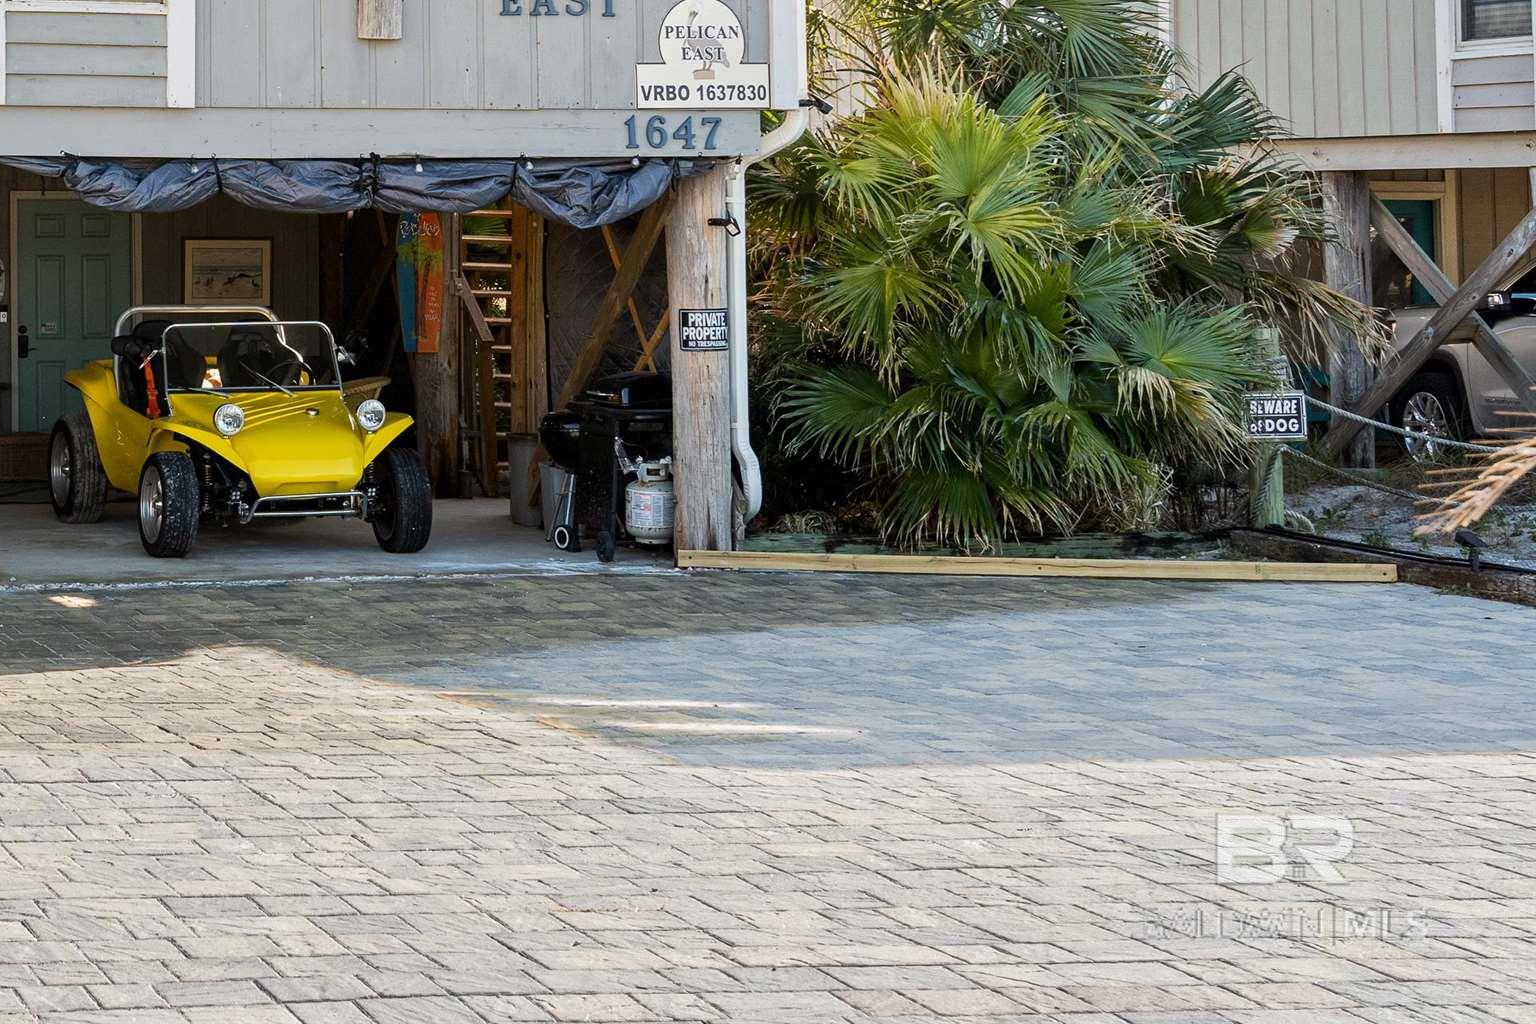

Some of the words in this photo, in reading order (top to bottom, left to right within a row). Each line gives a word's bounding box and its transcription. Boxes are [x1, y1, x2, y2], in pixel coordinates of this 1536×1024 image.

[664, 25, 739, 39] PELICAN
[681, 47, 724, 61] EAST
[640, 85, 690, 101] VRBO
[696, 84, 767, 101] 1637830
[624, 114, 722, 150] 1647
[688, 312, 725, 327] PRIVATE
[1249, 399, 1297, 414] BEWARE
[1265, 418, 1299, 432] DOG
